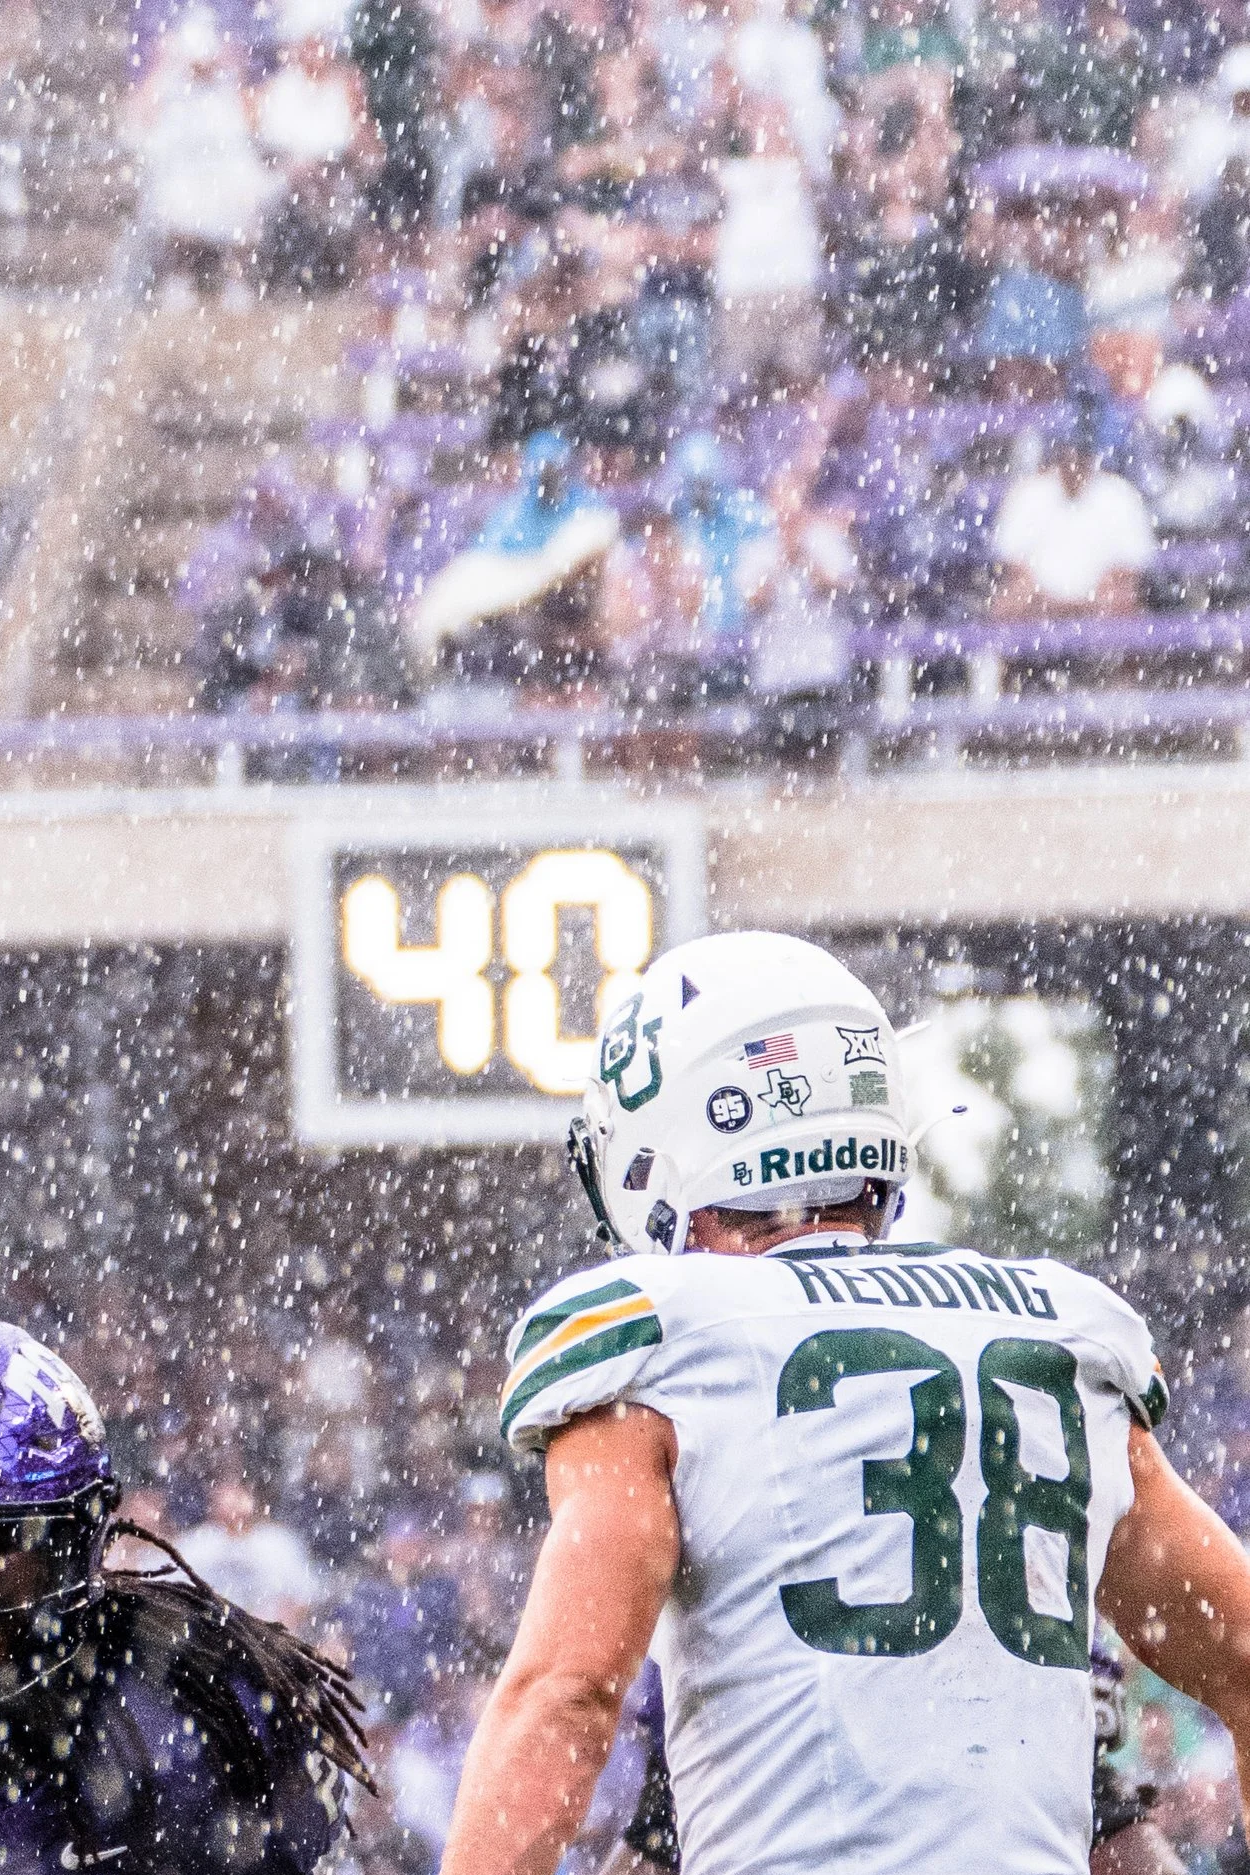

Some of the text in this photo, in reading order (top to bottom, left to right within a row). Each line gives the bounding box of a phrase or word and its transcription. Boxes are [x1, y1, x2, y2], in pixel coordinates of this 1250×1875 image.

[342, 849, 651, 1093] 40
[712, 1095, 746, 1124] 95
[760, 1137, 896, 1184] Riddell
[776, 1259, 1059, 1321] REDDING
[777, 1327, 1093, 1672] 38
